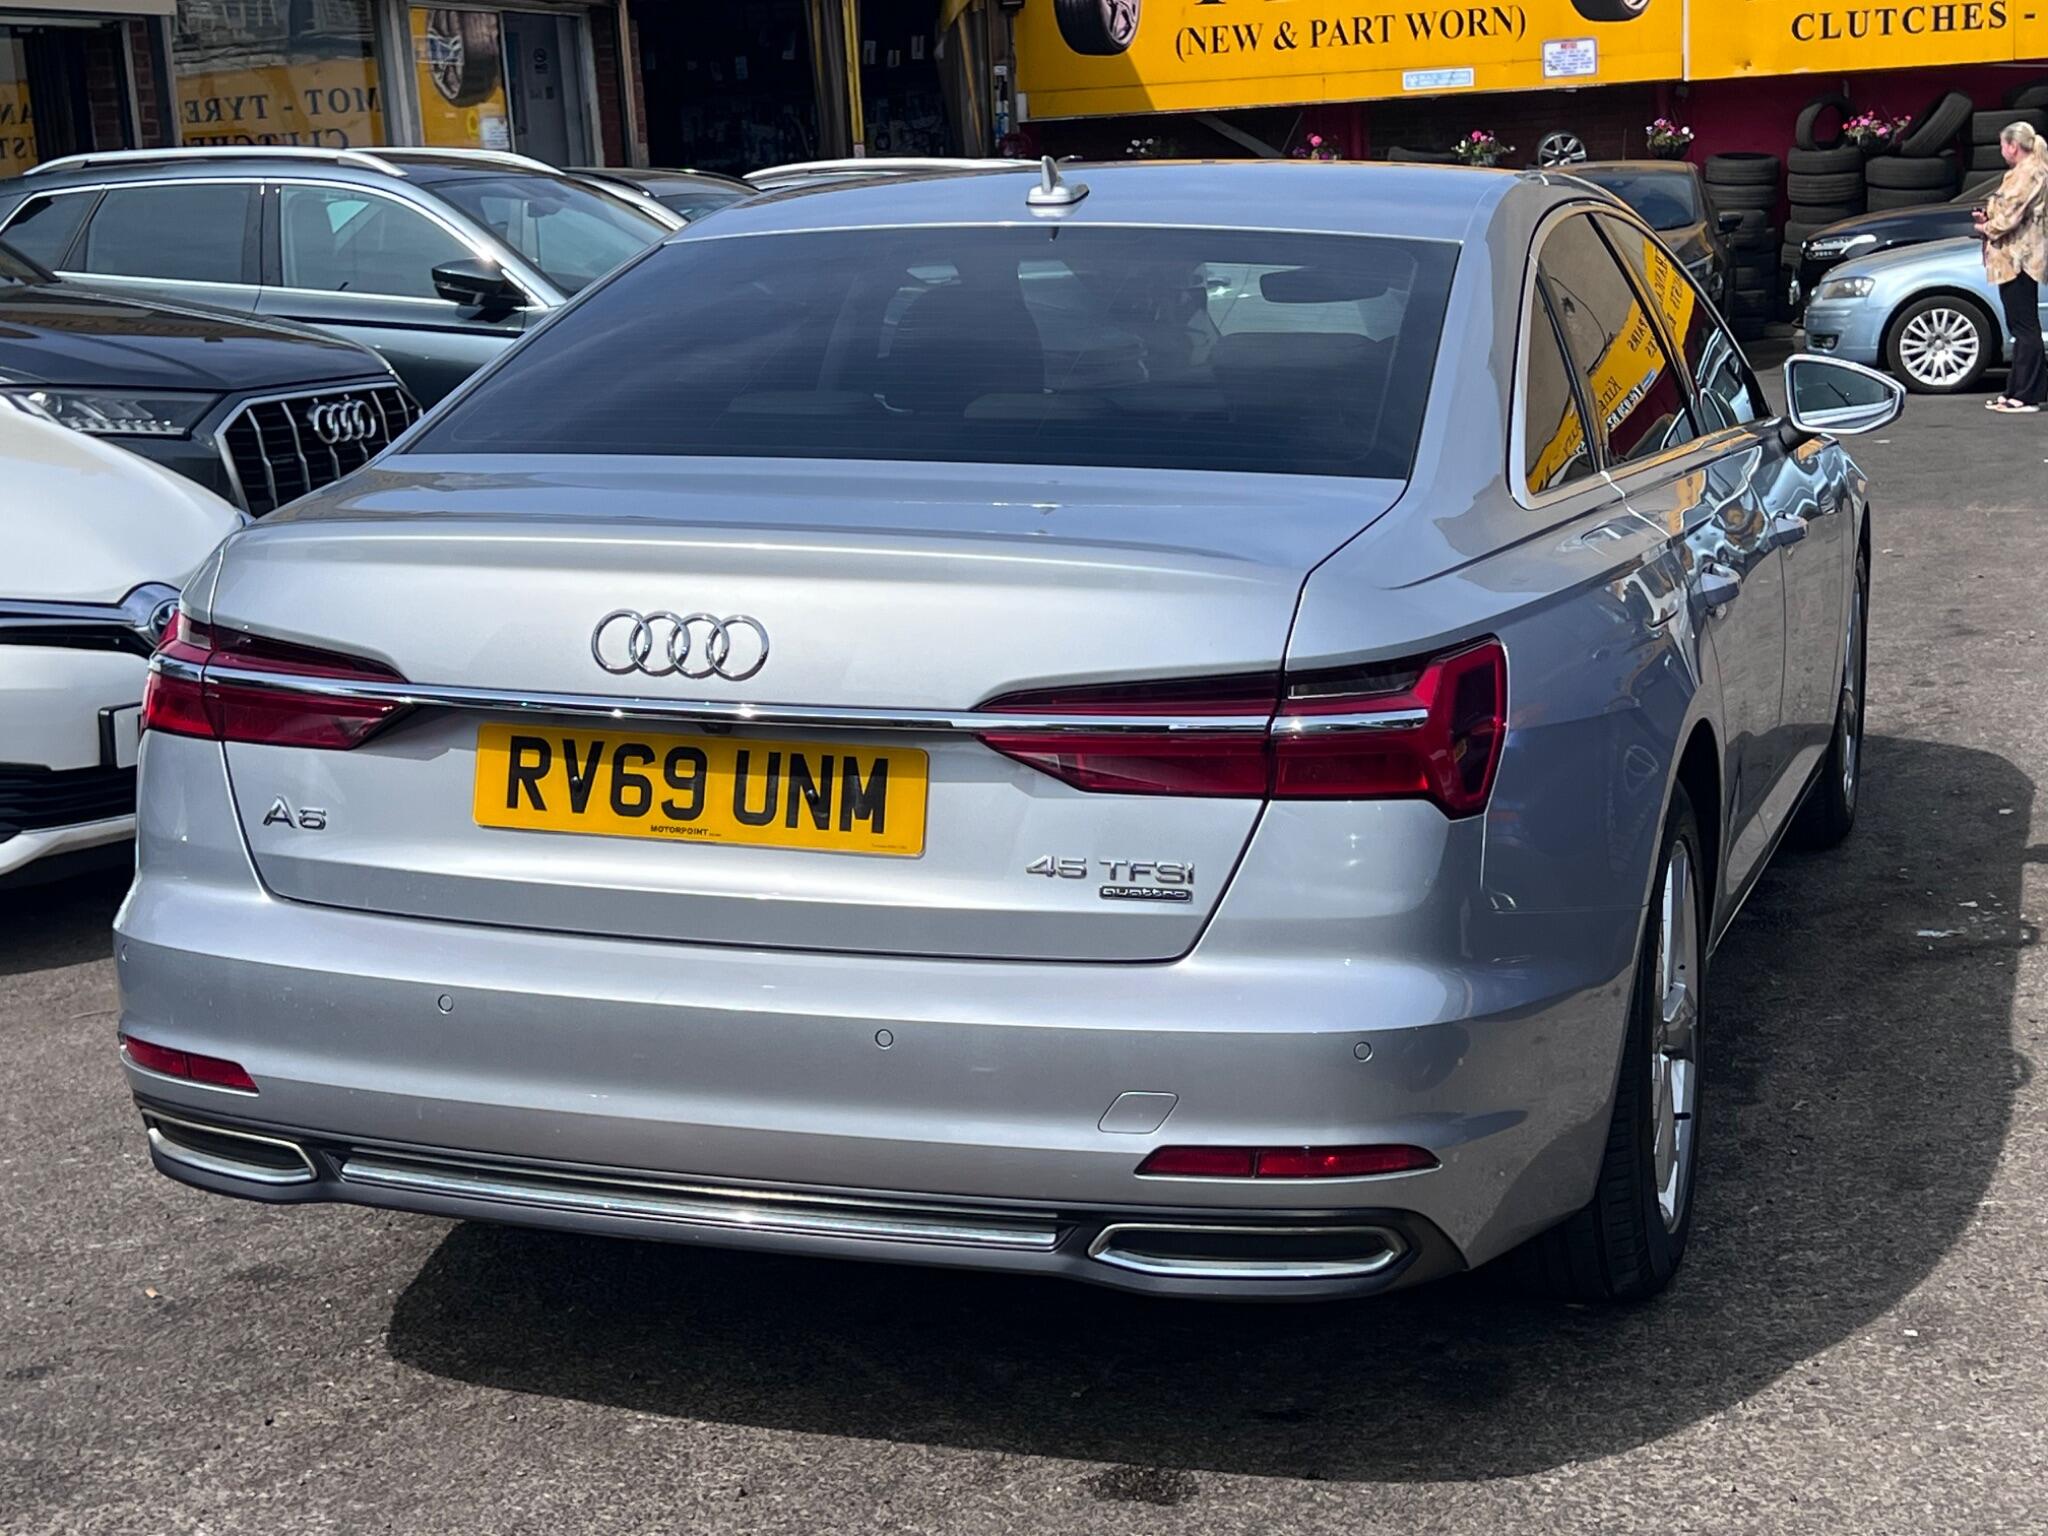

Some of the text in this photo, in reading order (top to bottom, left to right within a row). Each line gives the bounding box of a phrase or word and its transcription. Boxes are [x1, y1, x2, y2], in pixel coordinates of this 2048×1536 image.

[1175, 4, 1527, 63] (NEW & PART WORN)
[1791, 0, 2007, 41] CLUTCHES
[506, 735, 889, 835] RV69 UNM
[262, 794, 327, 831] A6
[650, 825, 709, 837] MOTORPOINT
[1026, 854, 1088, 880] 45
[1101, 887, 1190, 901] quattro
